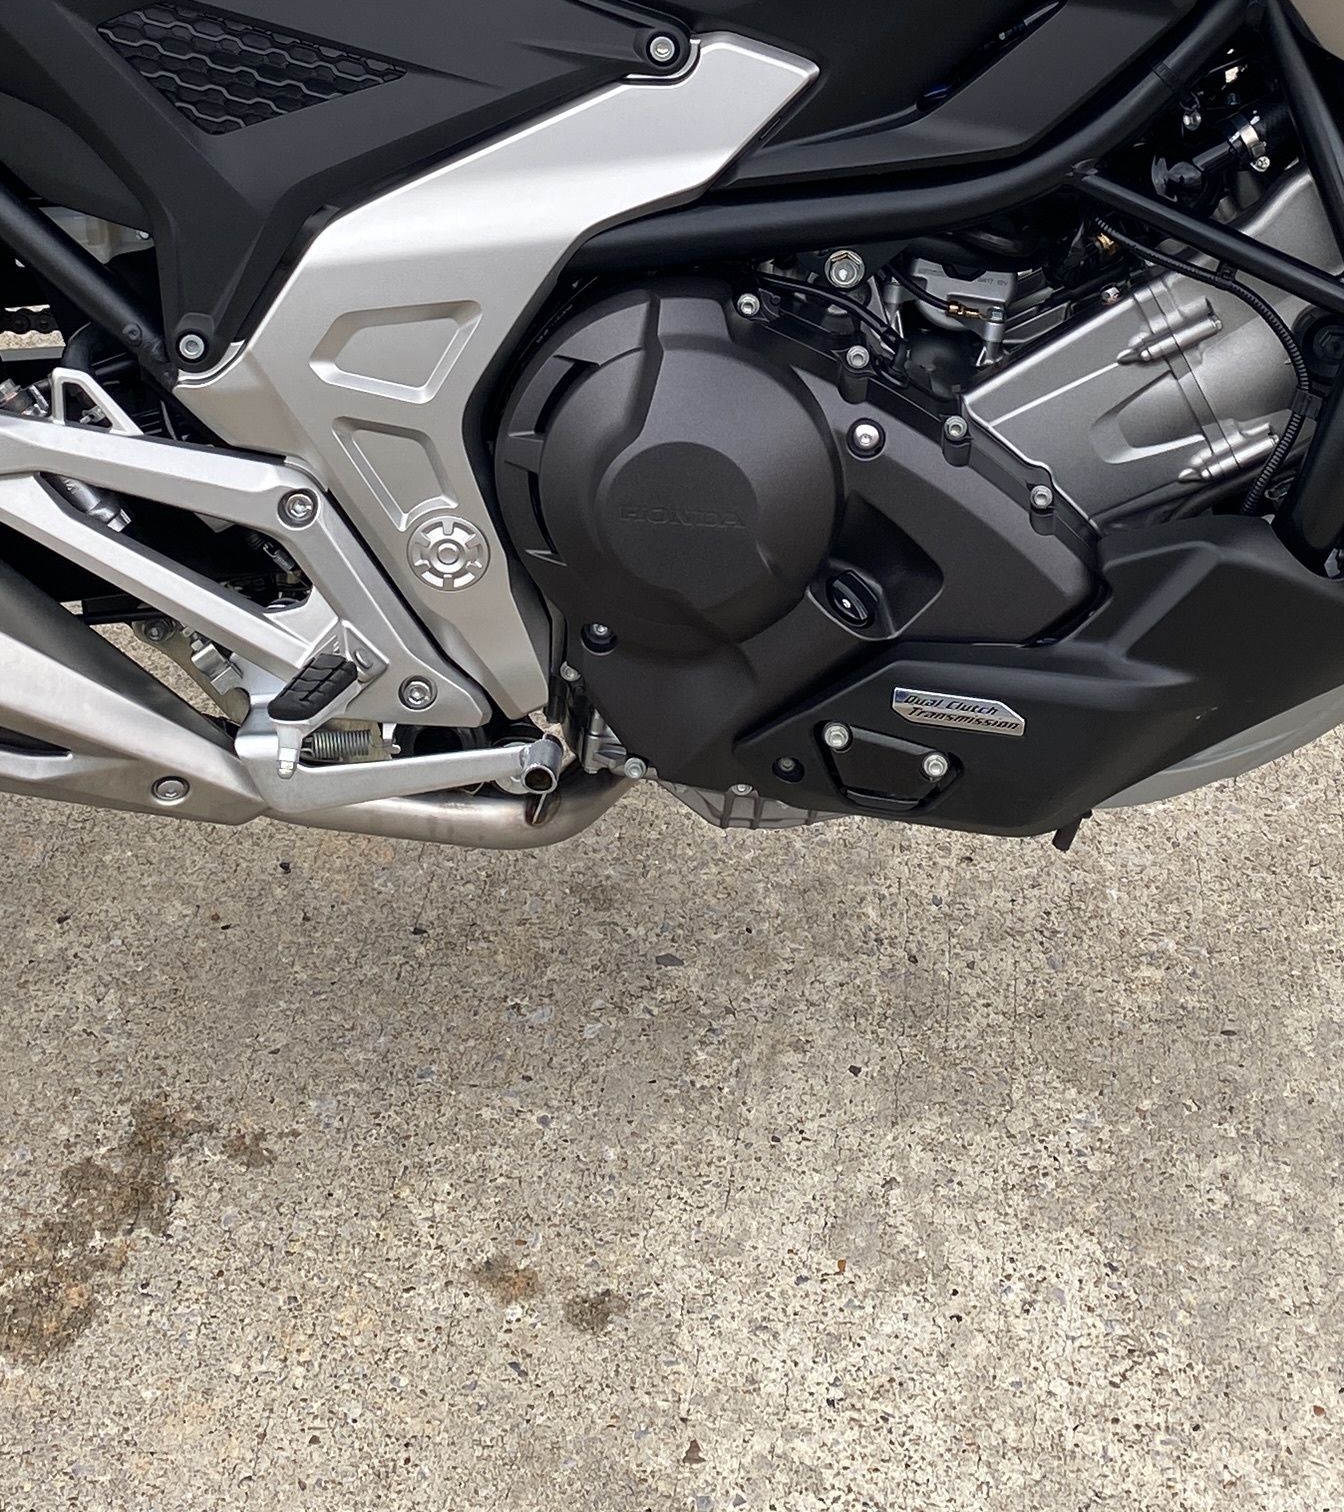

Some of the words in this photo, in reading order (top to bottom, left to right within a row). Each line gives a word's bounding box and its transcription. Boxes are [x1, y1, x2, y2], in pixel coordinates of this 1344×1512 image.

[618, 504, 747, 529] HONDA
[904, 695, 944, 708] Dual
[946, 700, 999, 716] Clutch
[908, 707, 1020, 730] Transmission
